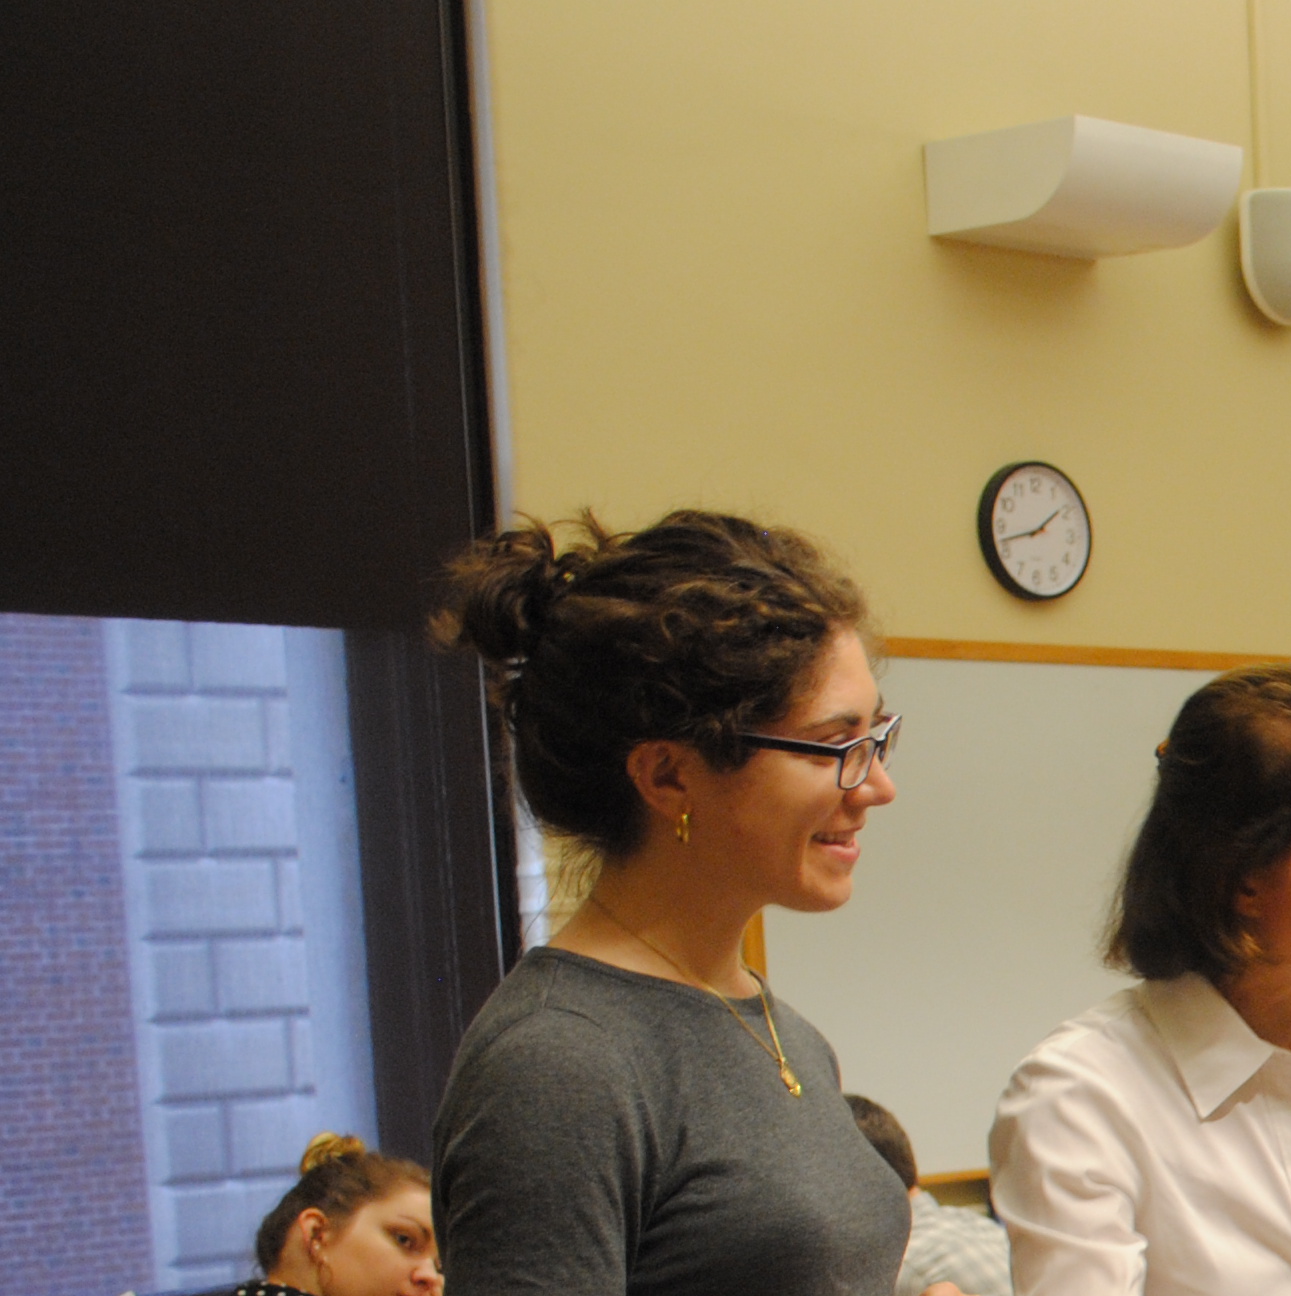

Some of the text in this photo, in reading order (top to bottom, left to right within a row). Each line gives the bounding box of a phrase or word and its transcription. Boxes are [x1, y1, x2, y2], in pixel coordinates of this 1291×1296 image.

[1013, 483, 1024, 497] 11
[1030, 477, 1041, 492] 12
[1051, 487, 1056, 499] 1
[1001, 497, 1015, 513] 10
[1061, 503, 1071, 520] 2
[1066, 530, 1075, 545] 3
[1062, 552, 1070, 565] 4
[1016, 560, 1025, 576] 7
[1049, 566, 1058, 581] 5
[1032, 569, 1041, 585] 6
